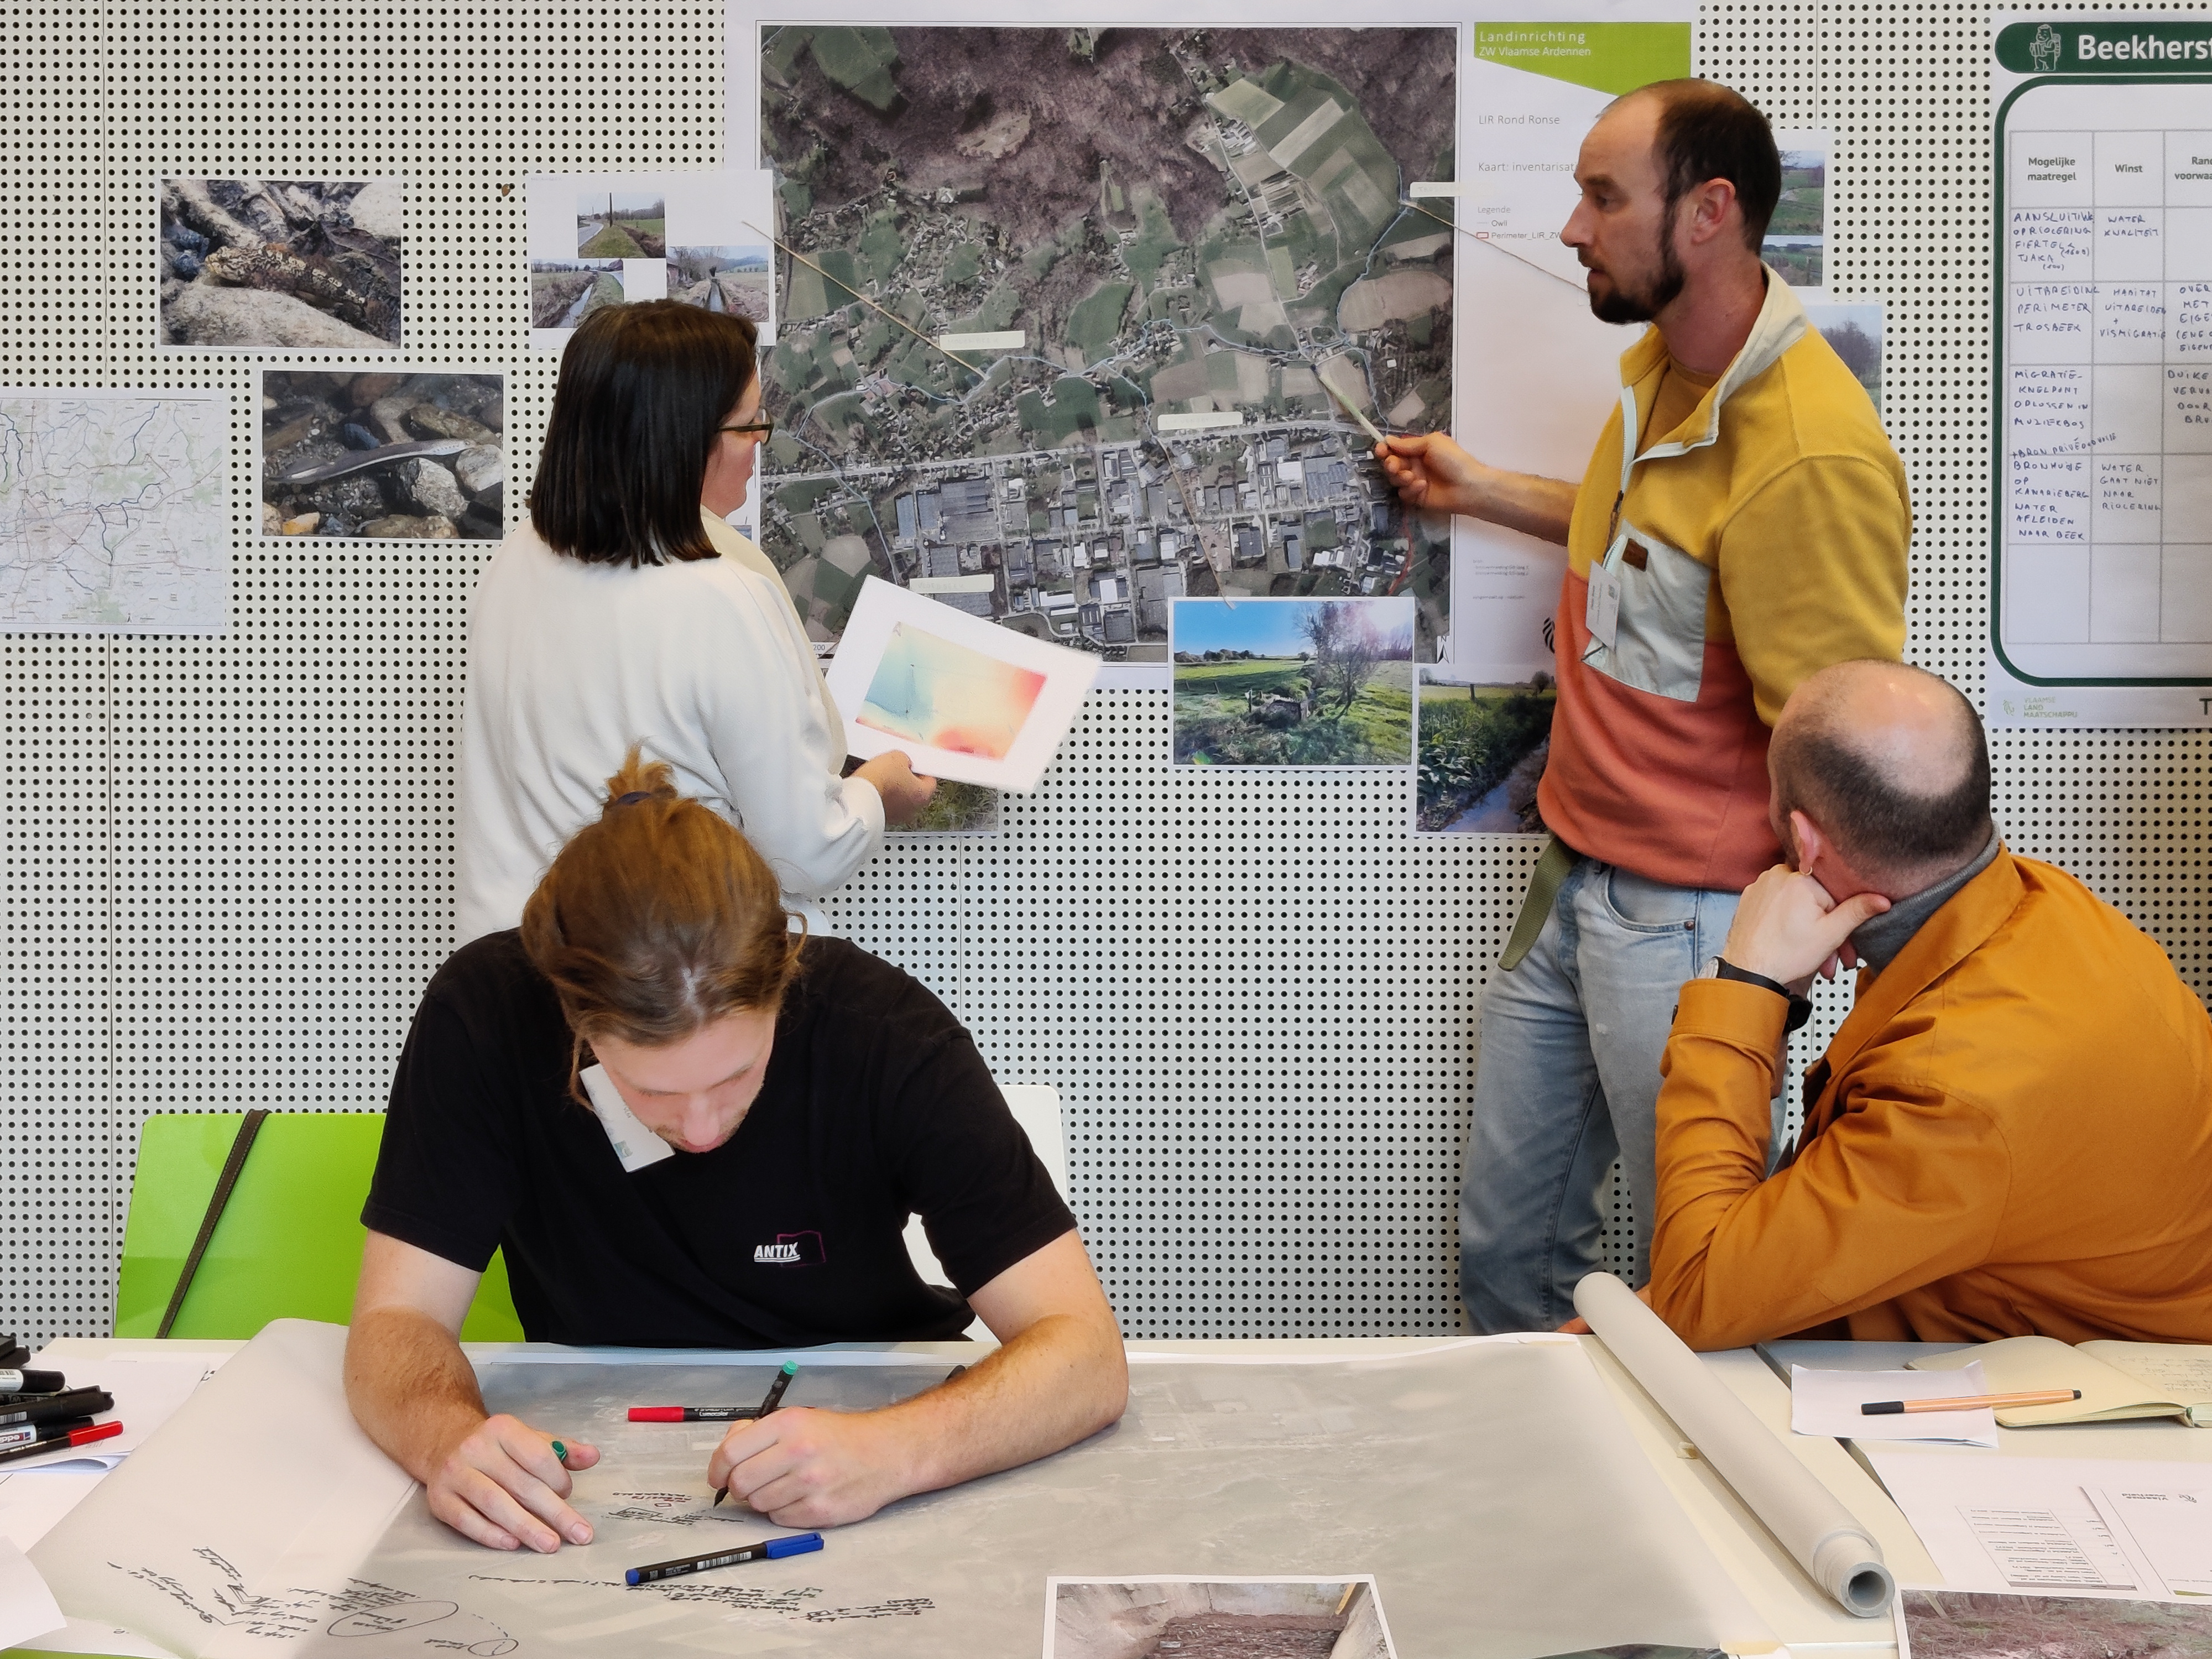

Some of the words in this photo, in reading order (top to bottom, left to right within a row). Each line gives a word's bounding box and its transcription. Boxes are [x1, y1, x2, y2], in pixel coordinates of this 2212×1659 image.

[1479, 31, 1585, 45] Landinrichting
[1479, 47, 1499, 56] ZW
[1501, 47, 1540, 56] Vlaamse
[1542, 47, 1591, 56] Ardennen
[1479, 116, 1494, 124] LIR
[1498, 115, 1525, 124] Rond
[1528, 116, 1560, 124] Ronse
[2028, 156, 2075, 168] Mogelijke
[1478, 163, 1509, 171] Kaart:
[1512, 163, 1577, 171] inventarisat
[2115, 164, 2143, 173] Winst
[2027, 171, 2077, 182] maatregel
[1478, 206, 1511, 215] Legende
[2109, 215, 2146, 223] WATER
[2104, 228, 2158, 237] KWALITEIT
[2114, 289, 2157, 298] HABITAT
[2017, 303, 2091, 314] PERIMETER
[2101, 464, 2143, 472] WATER
[2100, 476, 2128, 485] GAAT
[2015, 503, 2058, 513] WATER
[2016, 515, 2074, 525] AFLEIDEN
[2018, 529, 2049, 538] NAAR
[2057, 531, 2084, 540] BEEK
[754, 1242, 799, 1259] ANTIX
